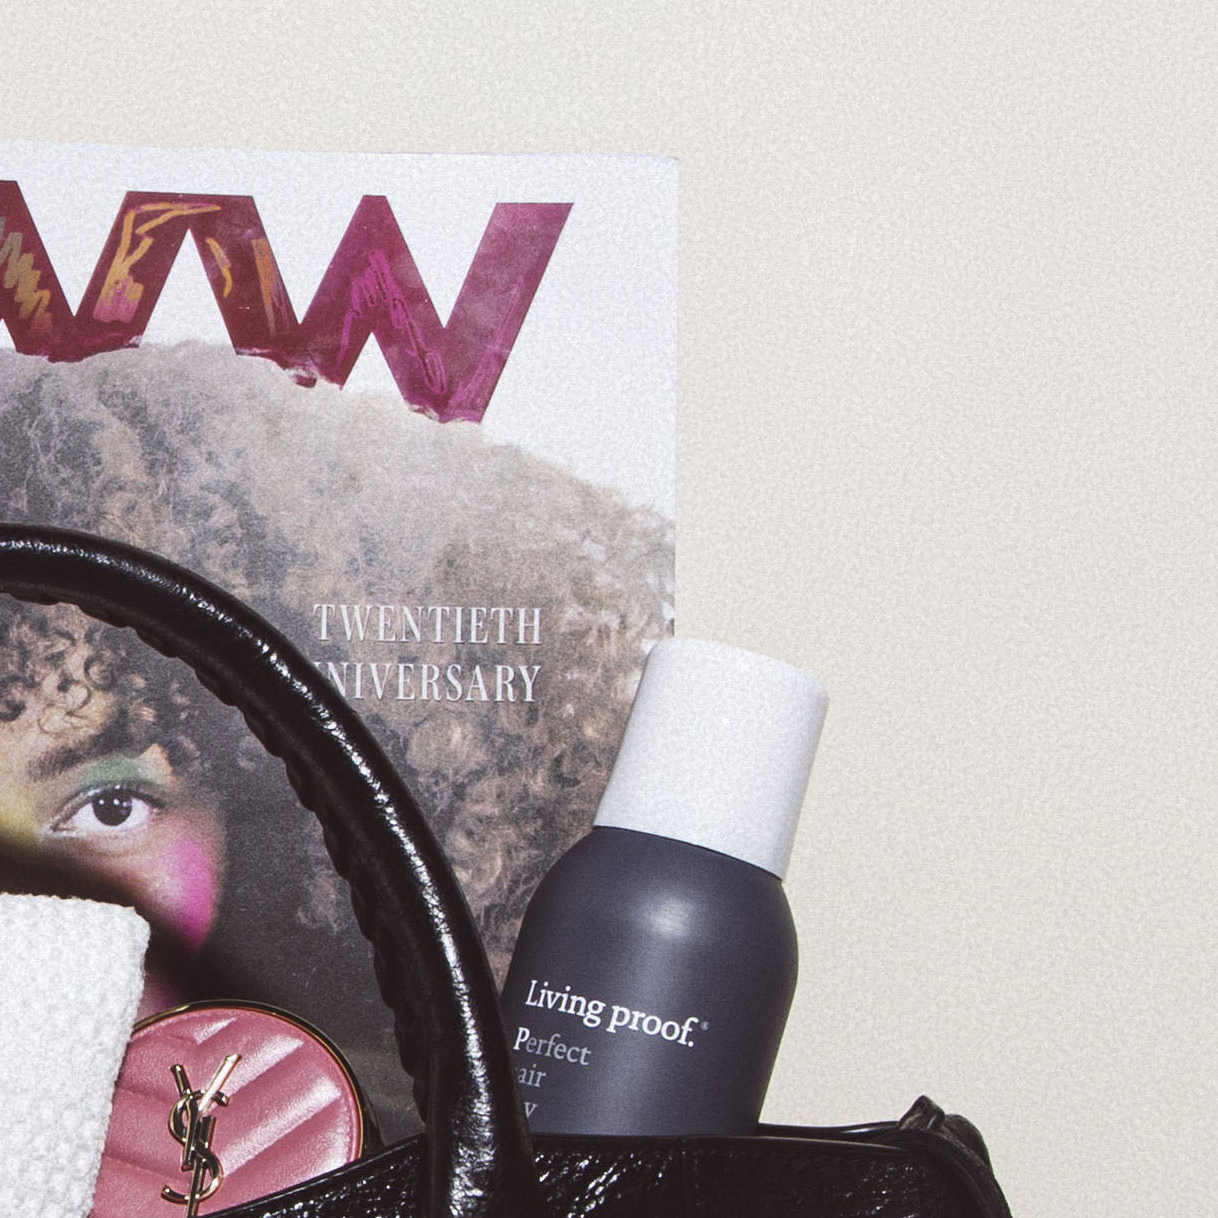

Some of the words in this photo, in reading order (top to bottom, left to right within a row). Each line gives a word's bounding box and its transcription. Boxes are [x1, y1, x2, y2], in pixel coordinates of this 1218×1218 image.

[313, 604, 542, 645] TWENTIETH
[313, 661, 542, 702] NIVERSARY
[525, 979, 607, 1028] Living
[513, 1027, 592, 1067] Perfect
[515, 1063, 547, 1089] air
